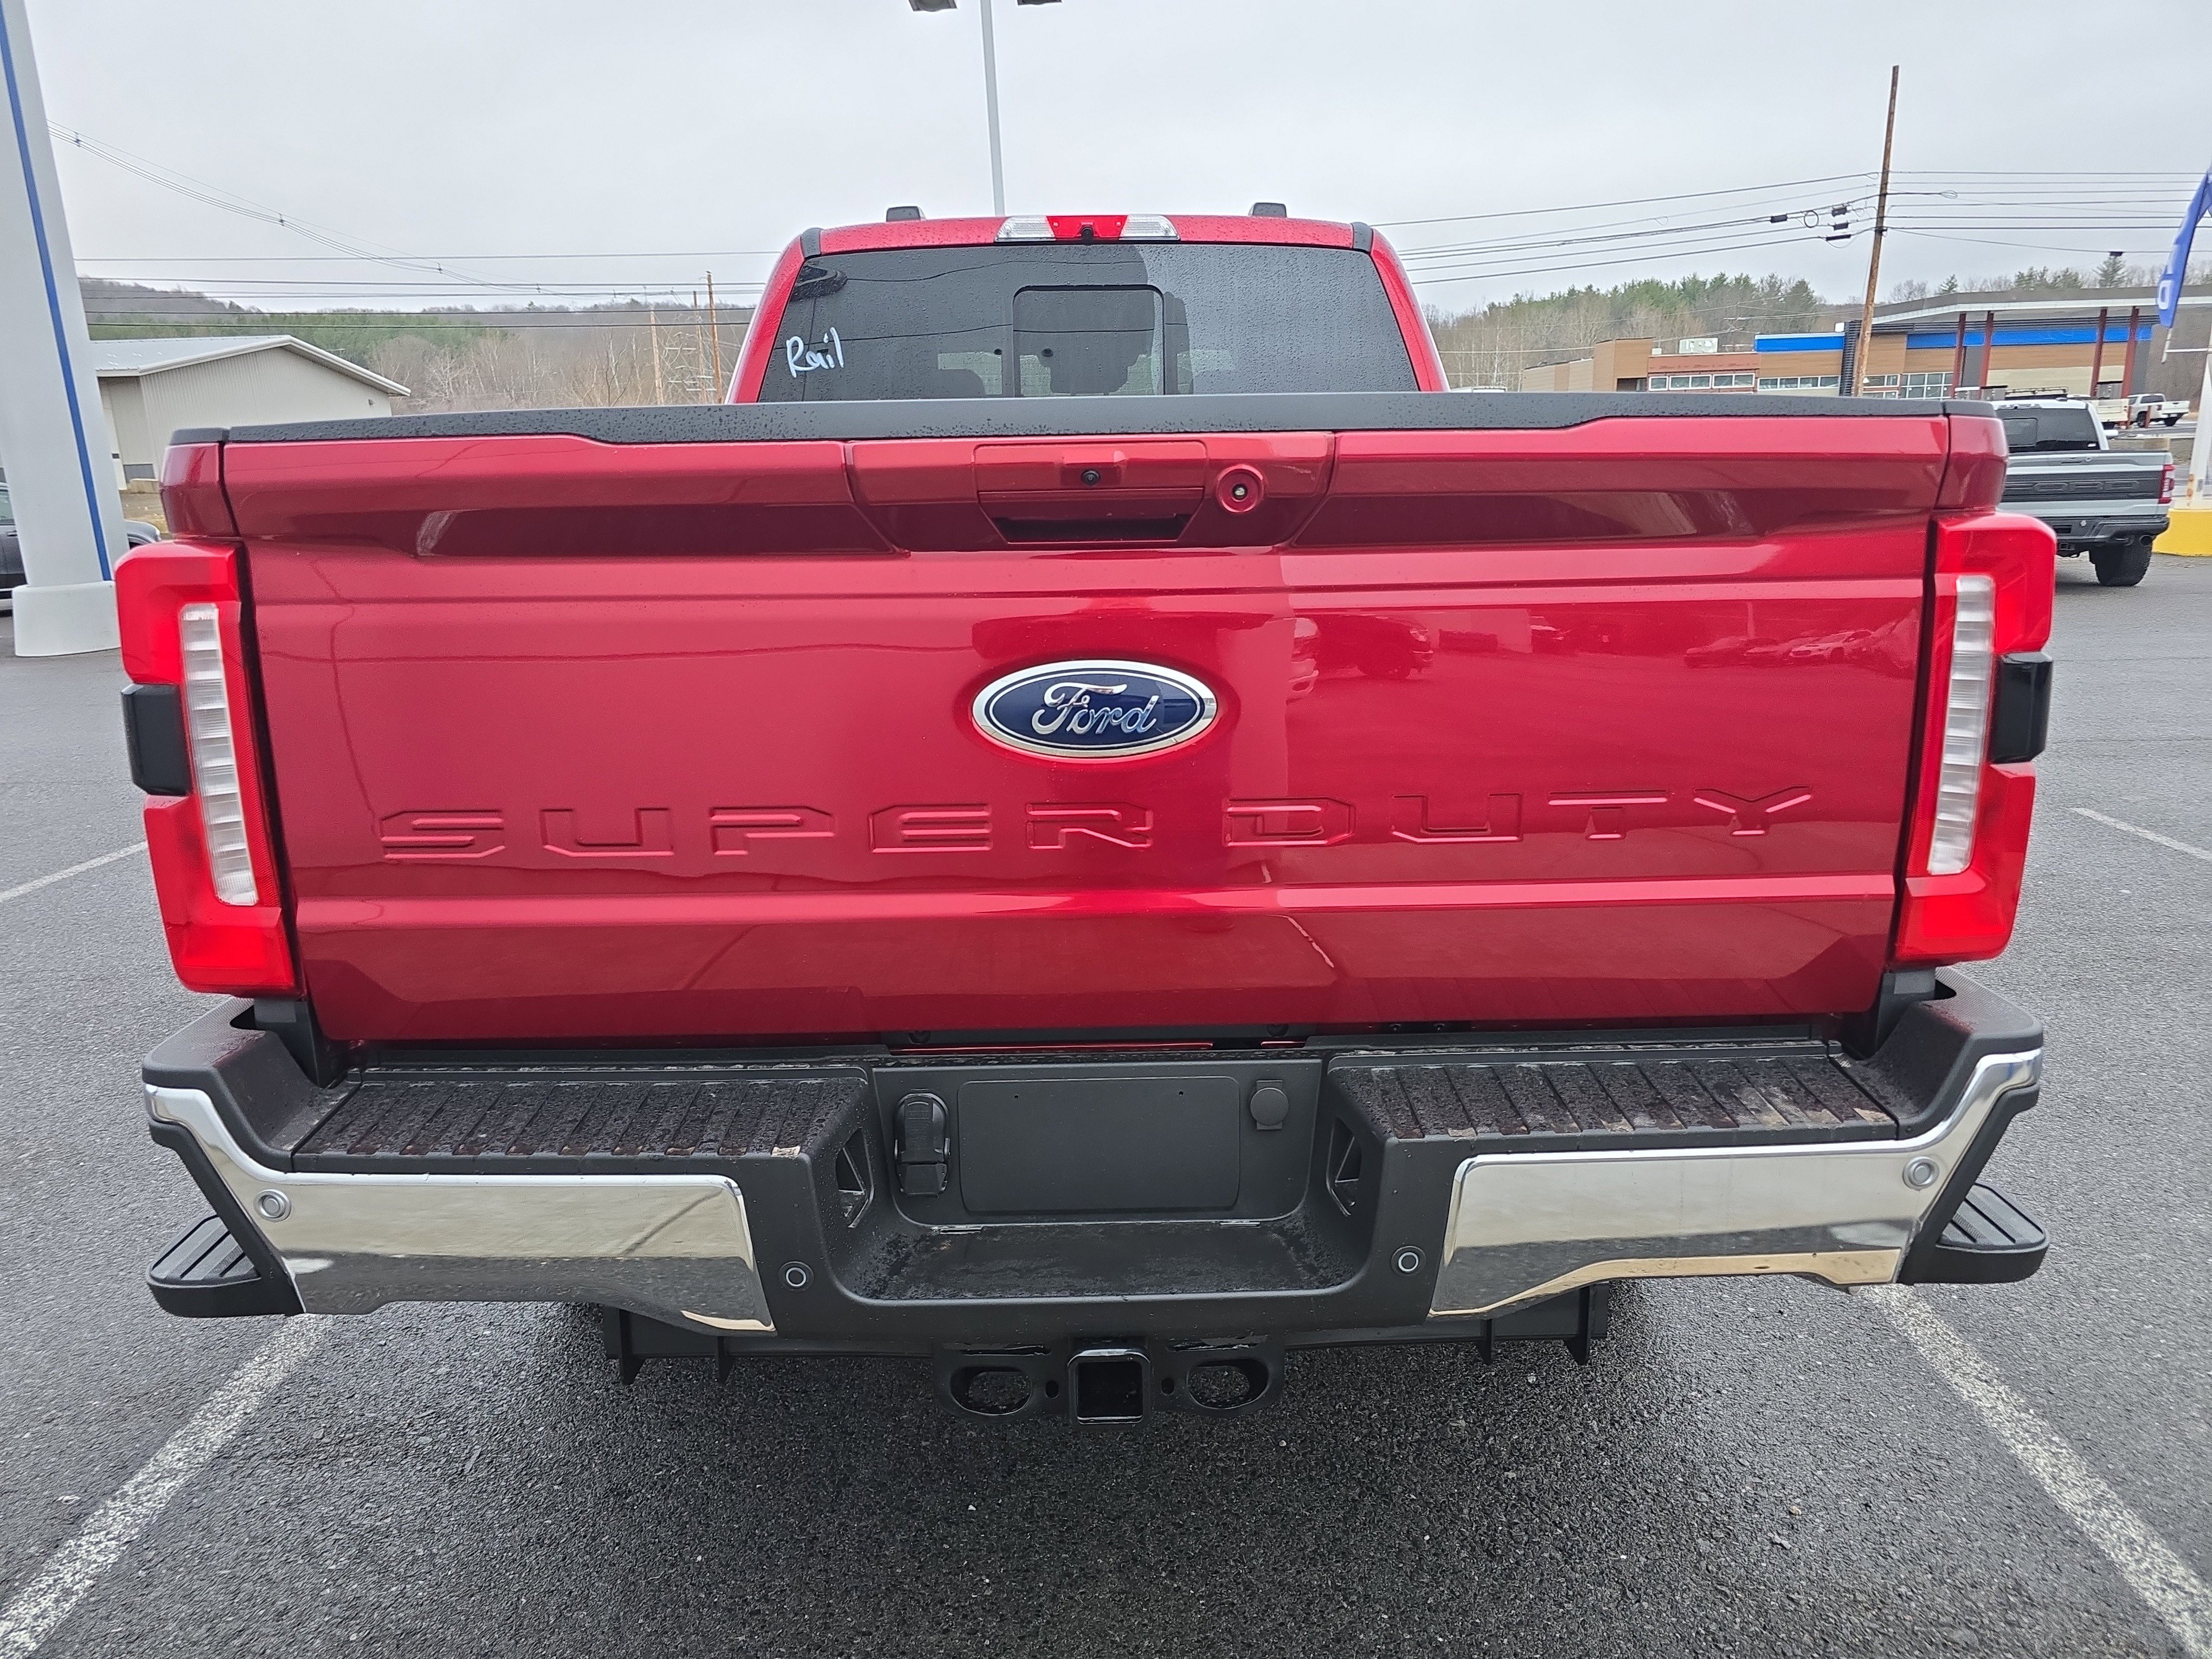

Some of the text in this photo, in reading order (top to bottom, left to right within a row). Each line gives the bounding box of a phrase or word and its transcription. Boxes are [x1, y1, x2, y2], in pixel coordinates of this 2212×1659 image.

[786, 327, 844, 378] Rail
[1032, 682, 1159, 735] Ford
[380, 786, 1813, 858] SUPER DUTY
